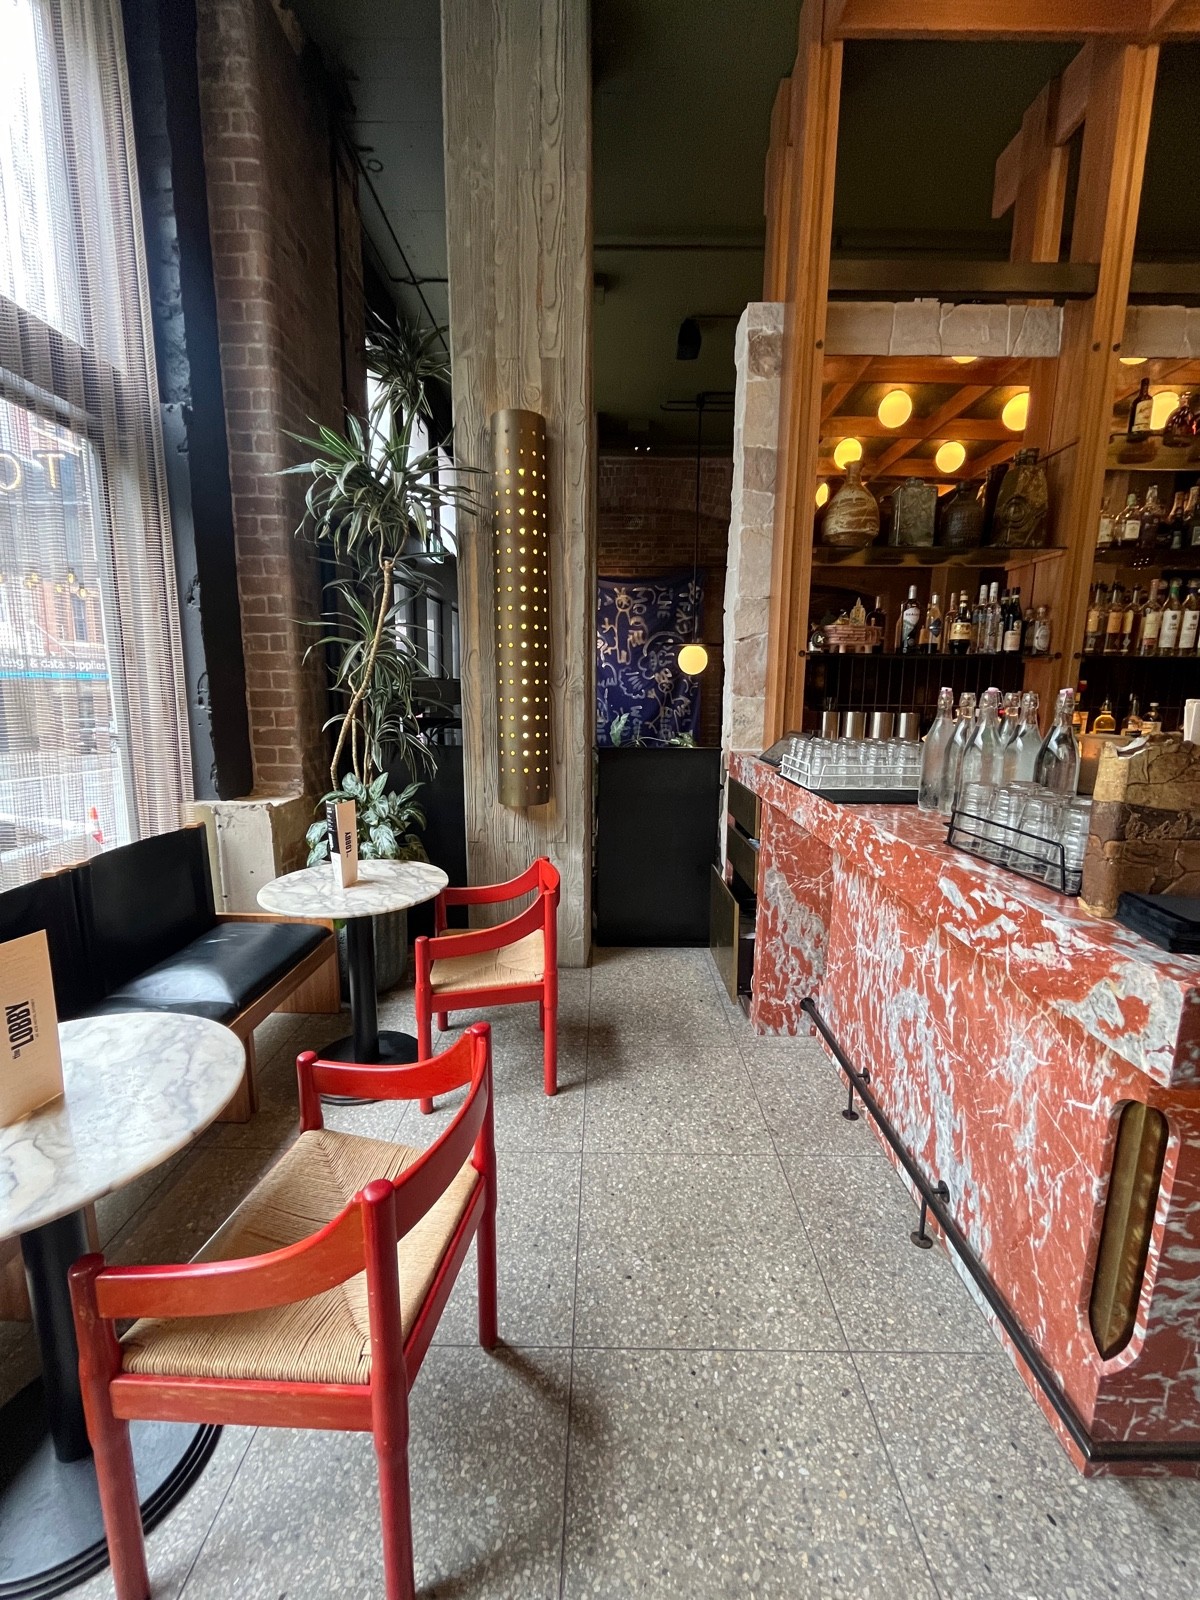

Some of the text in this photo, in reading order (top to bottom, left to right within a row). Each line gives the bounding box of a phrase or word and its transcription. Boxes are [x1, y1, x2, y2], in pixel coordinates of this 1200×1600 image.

[40, 658, 65, 669] data
[70, 660, 106, 671] supplies
[5, 1000, 34, 1051] LOBBY
